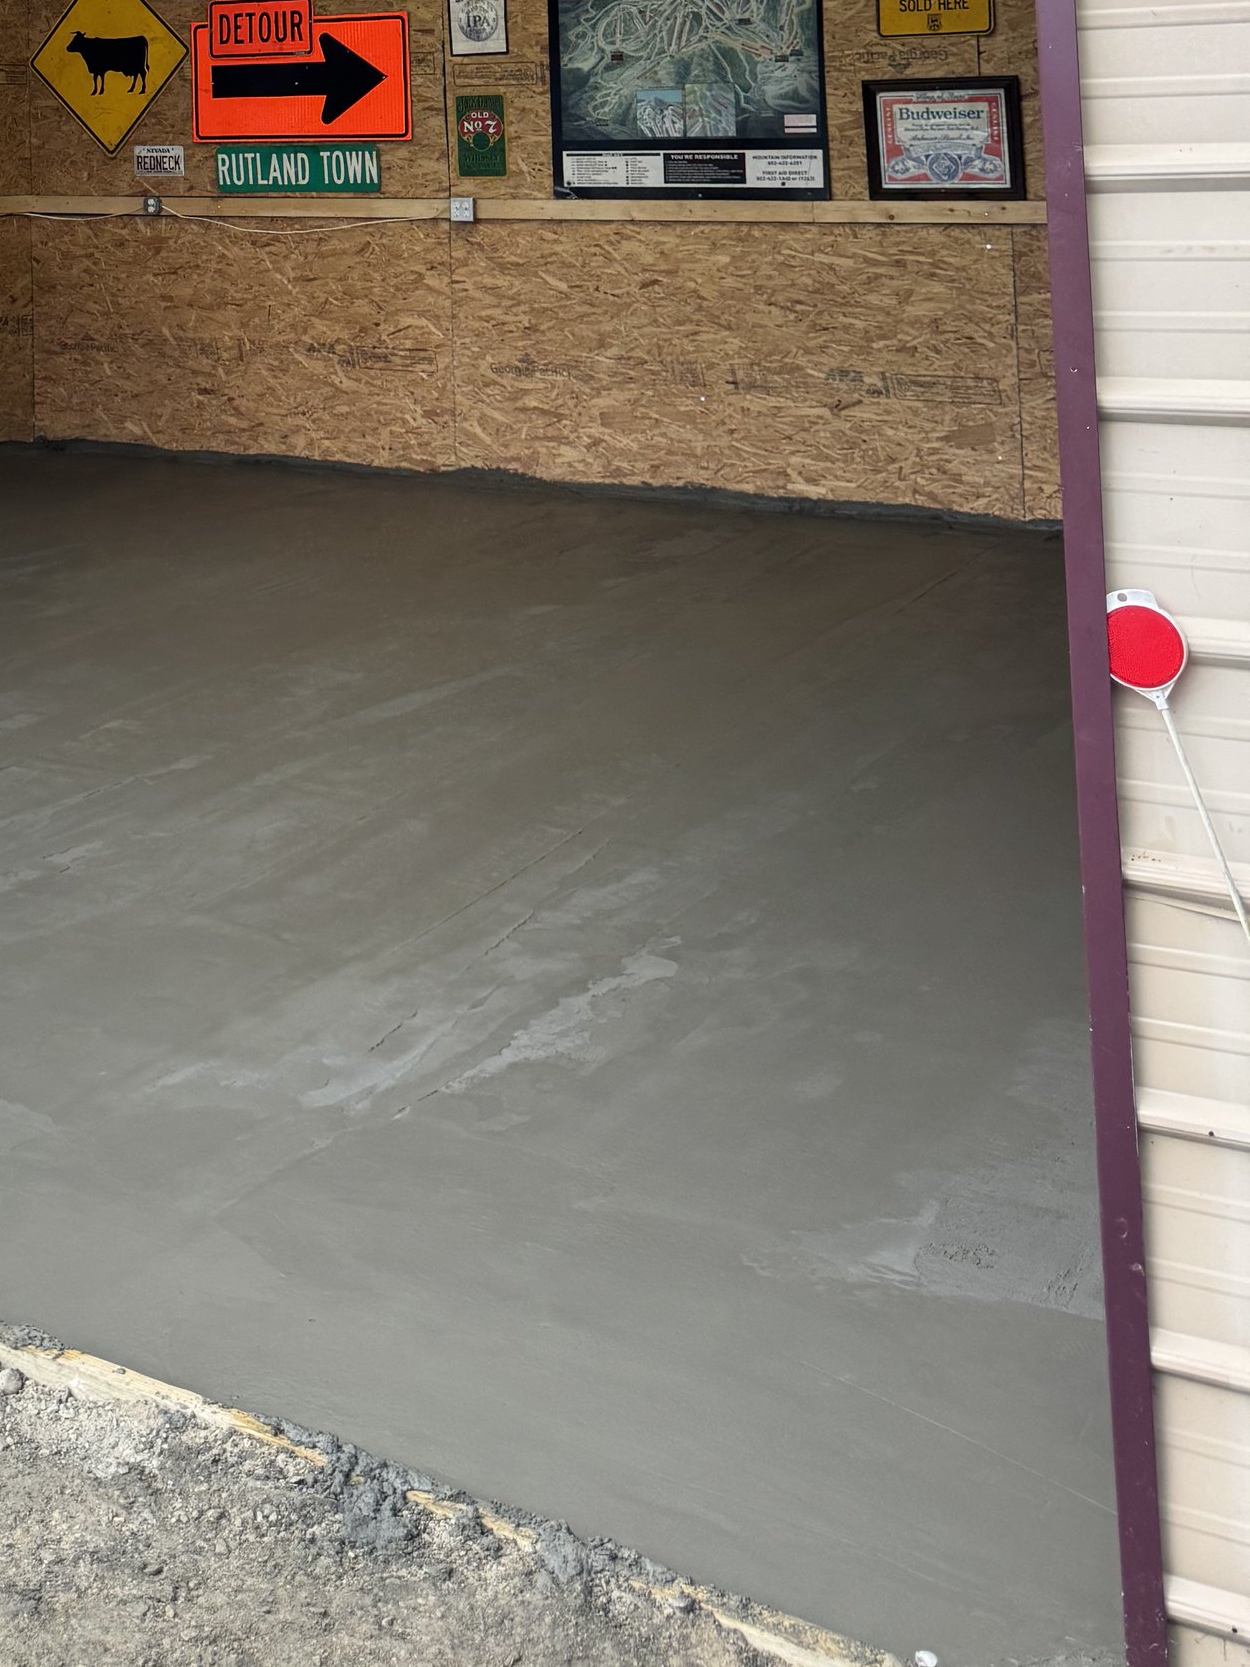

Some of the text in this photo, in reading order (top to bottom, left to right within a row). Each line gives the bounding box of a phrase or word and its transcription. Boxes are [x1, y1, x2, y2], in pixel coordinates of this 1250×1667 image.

[218, 10, 304, 45] DETOUR
[466, 15, 490, 28] IPA
[470, 111, 490, 119] OLD
[897, 106, 984, 121] Budweiser
[484, 120, 498, 134] 7
[136, 155, 181, 171] REDNECK
[217, 150, 379, 186] RUTLAND TOWN
